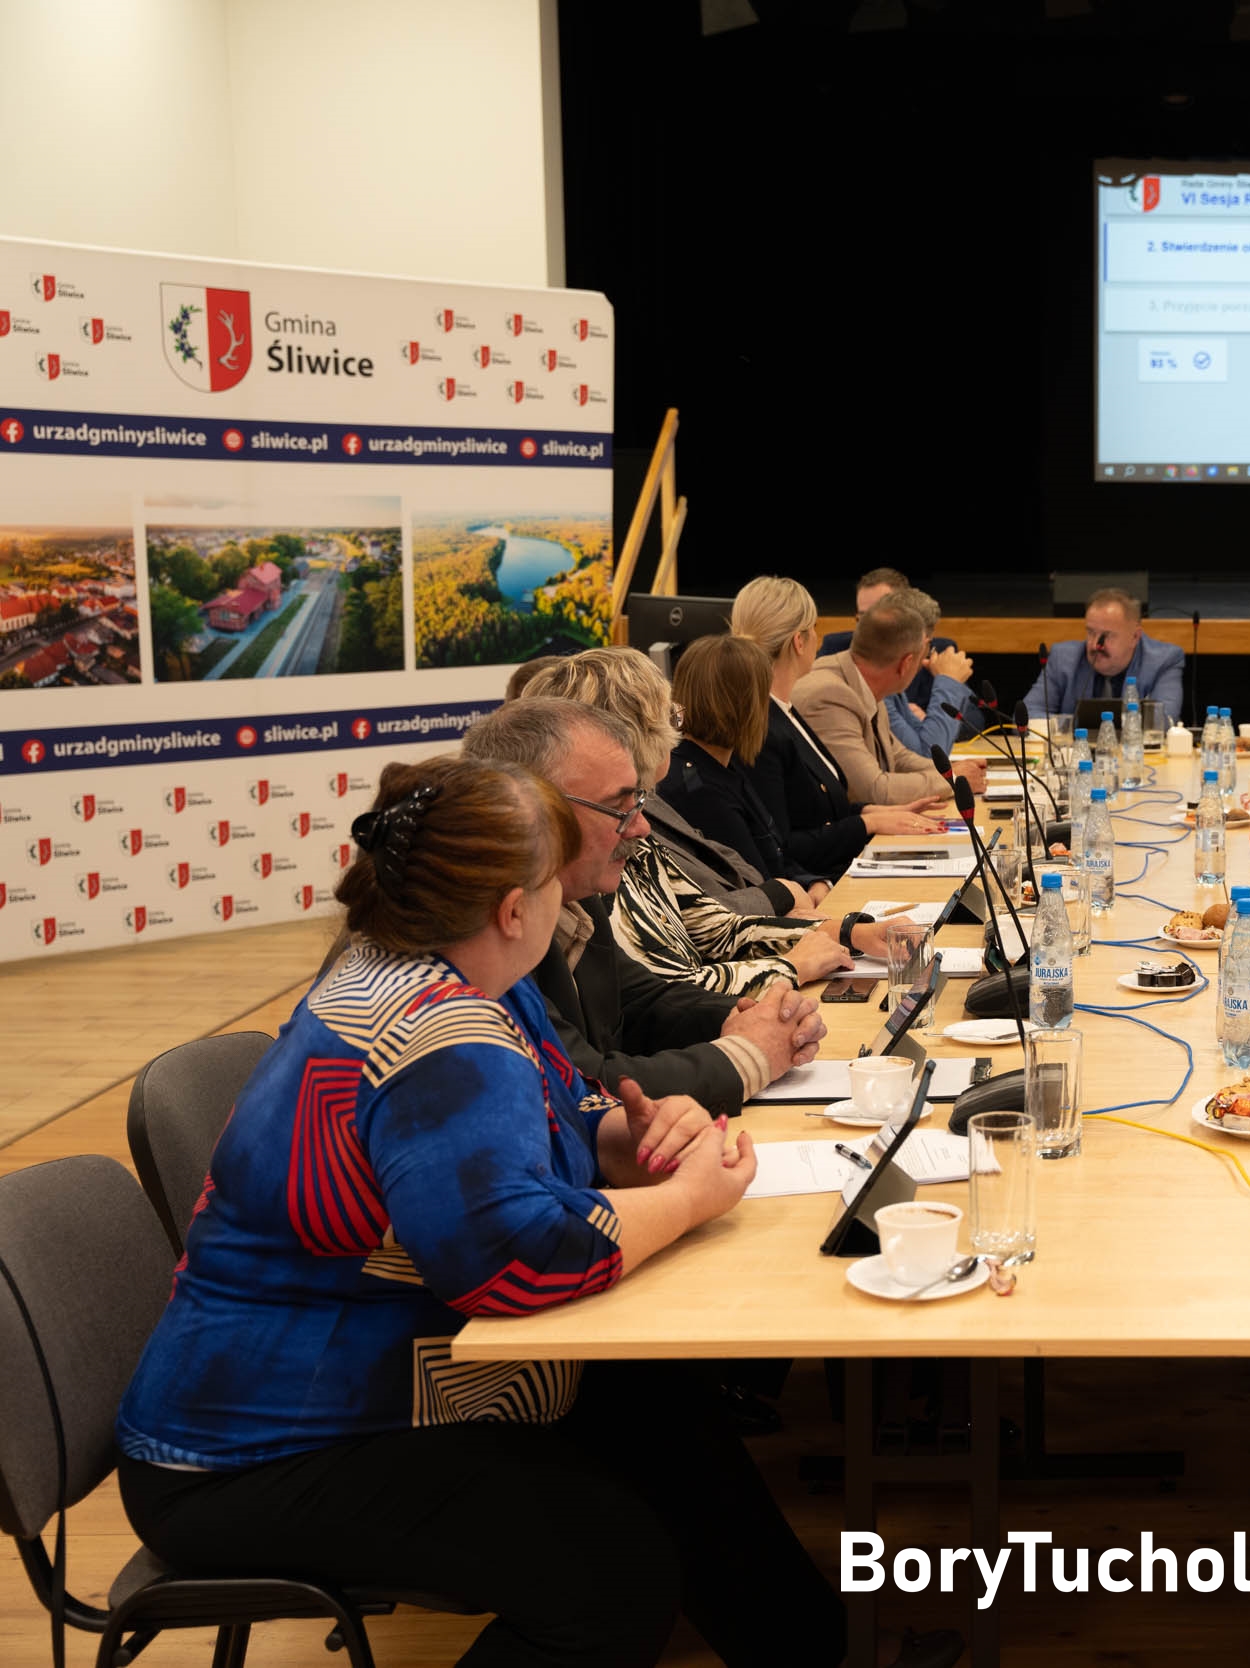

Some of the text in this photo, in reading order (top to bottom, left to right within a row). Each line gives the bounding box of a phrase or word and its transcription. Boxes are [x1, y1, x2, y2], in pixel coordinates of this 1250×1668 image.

[1181, 193, 1196, 204] VI
[1201, 193, 1240, 207] Sesja
[1162, 241, 1239, 253] Stwierdzenie
[264, 311, 337, 336] Gmina
[267, 339, 374, 377] Śliwice
[33, 423, 207, 448] urzadgminysliwice
[251, 431, 328, 454] sliwice.pl
[368, 436, 508, 457] urzadgminysliwice
[542, 440, 604, 460] sliwice.pl
[54, 731, 221, 758] urzadgminysliwice
[264, 722, 339, 744] sliwice.pl
[1035, 967, 1068, 978] JURAJSKA
